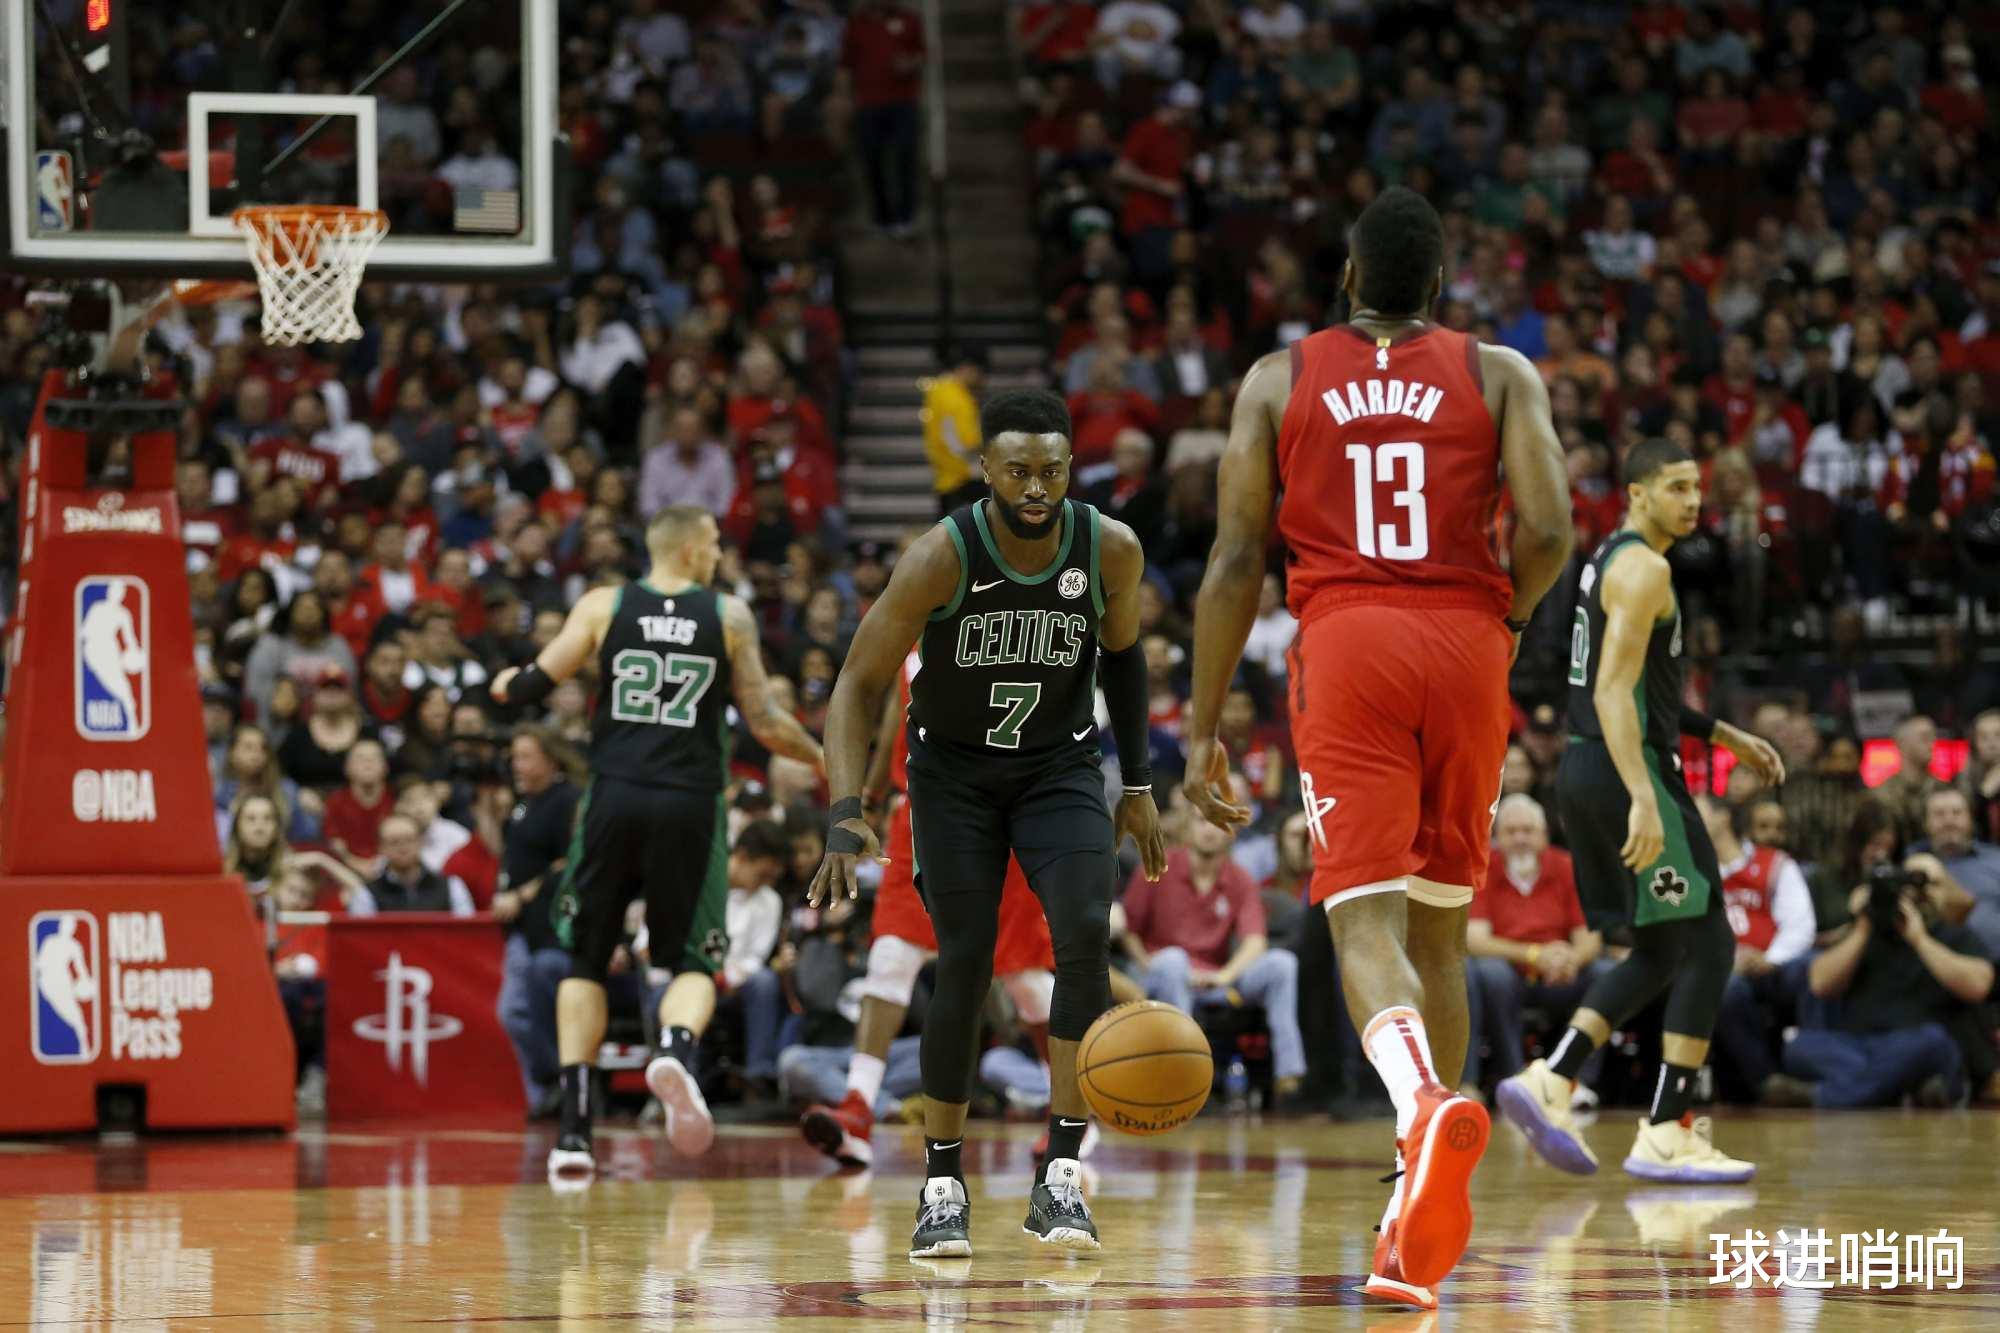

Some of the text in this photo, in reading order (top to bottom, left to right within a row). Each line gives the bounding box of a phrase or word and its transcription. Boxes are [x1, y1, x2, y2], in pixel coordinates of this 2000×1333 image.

[1321, 379, 1444, 426] HARDEN
[63, 506, 162, 535] SPALDING
[1345, 441, 1429, 560] 13
[955, 610, 1087, 668] CELTICS
[611, 648, 717, 728] 27
[985, 682, 1042, 749] 7
[72, 768, 157, 822] @NBA
[108, 912, 167, 963] NBA
[109, 958, 214, 1018] League
[109, 1008, 183, 1061] Pass
